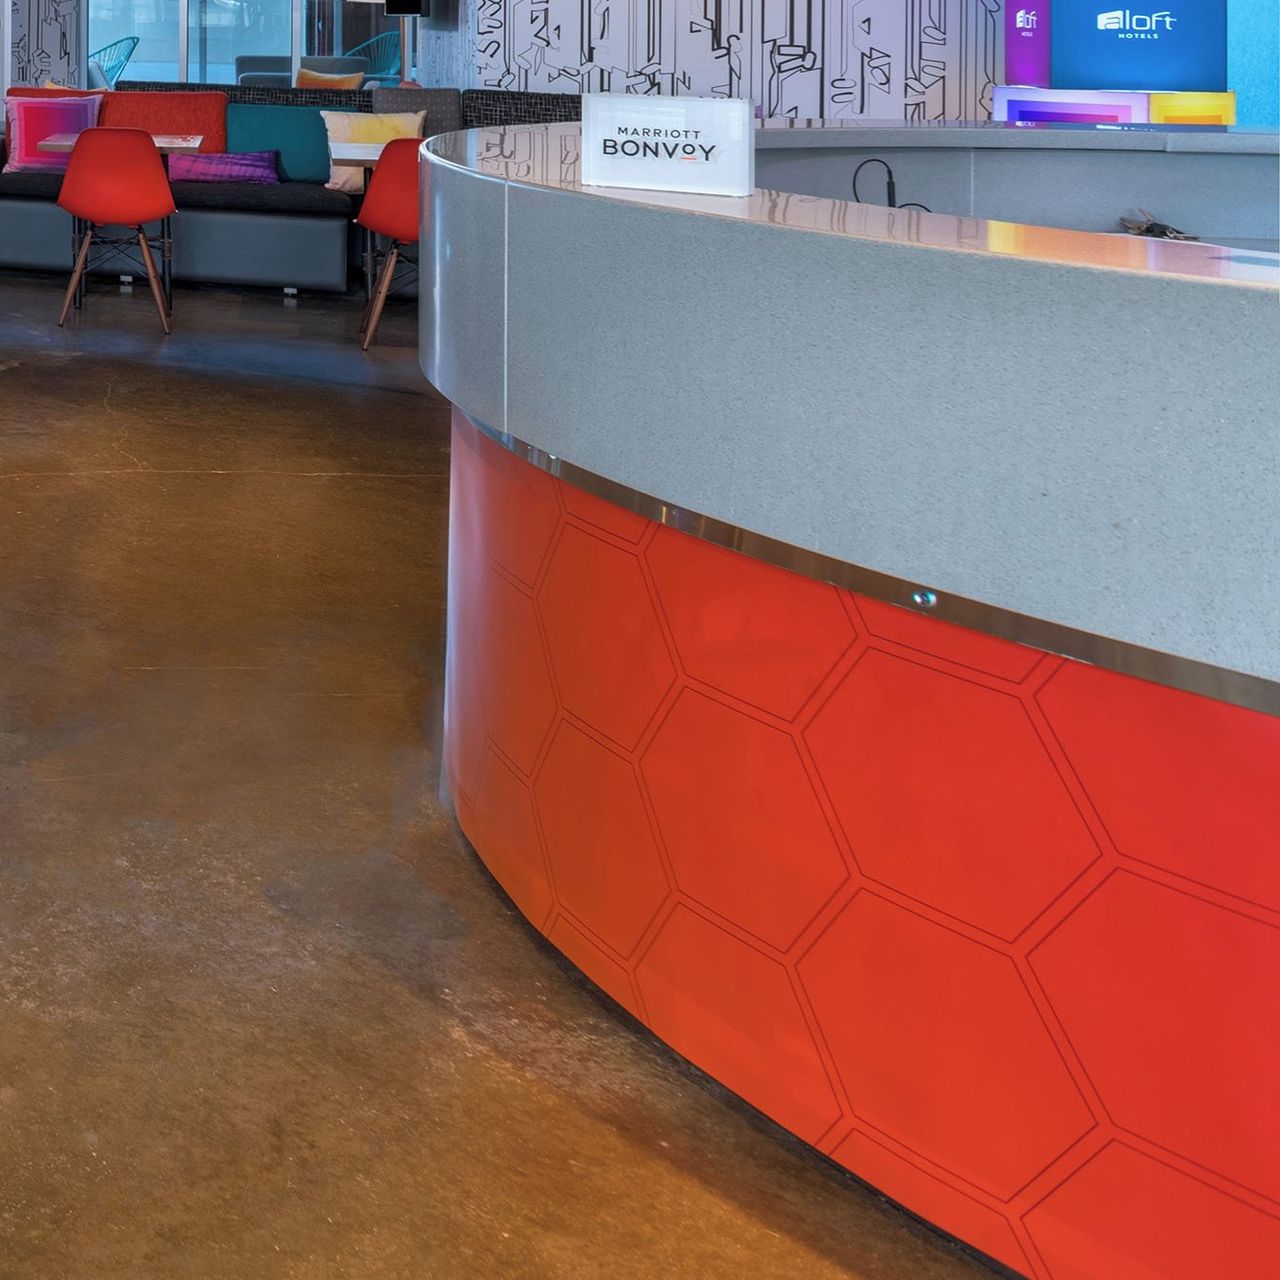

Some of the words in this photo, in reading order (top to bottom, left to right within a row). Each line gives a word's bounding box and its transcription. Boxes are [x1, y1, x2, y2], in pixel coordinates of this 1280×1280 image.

[1097, 9, 1177, 30] aloft
[617, 126, 701, 140] MARRIOTT
[602, 138, 716, 162] BONVOY
